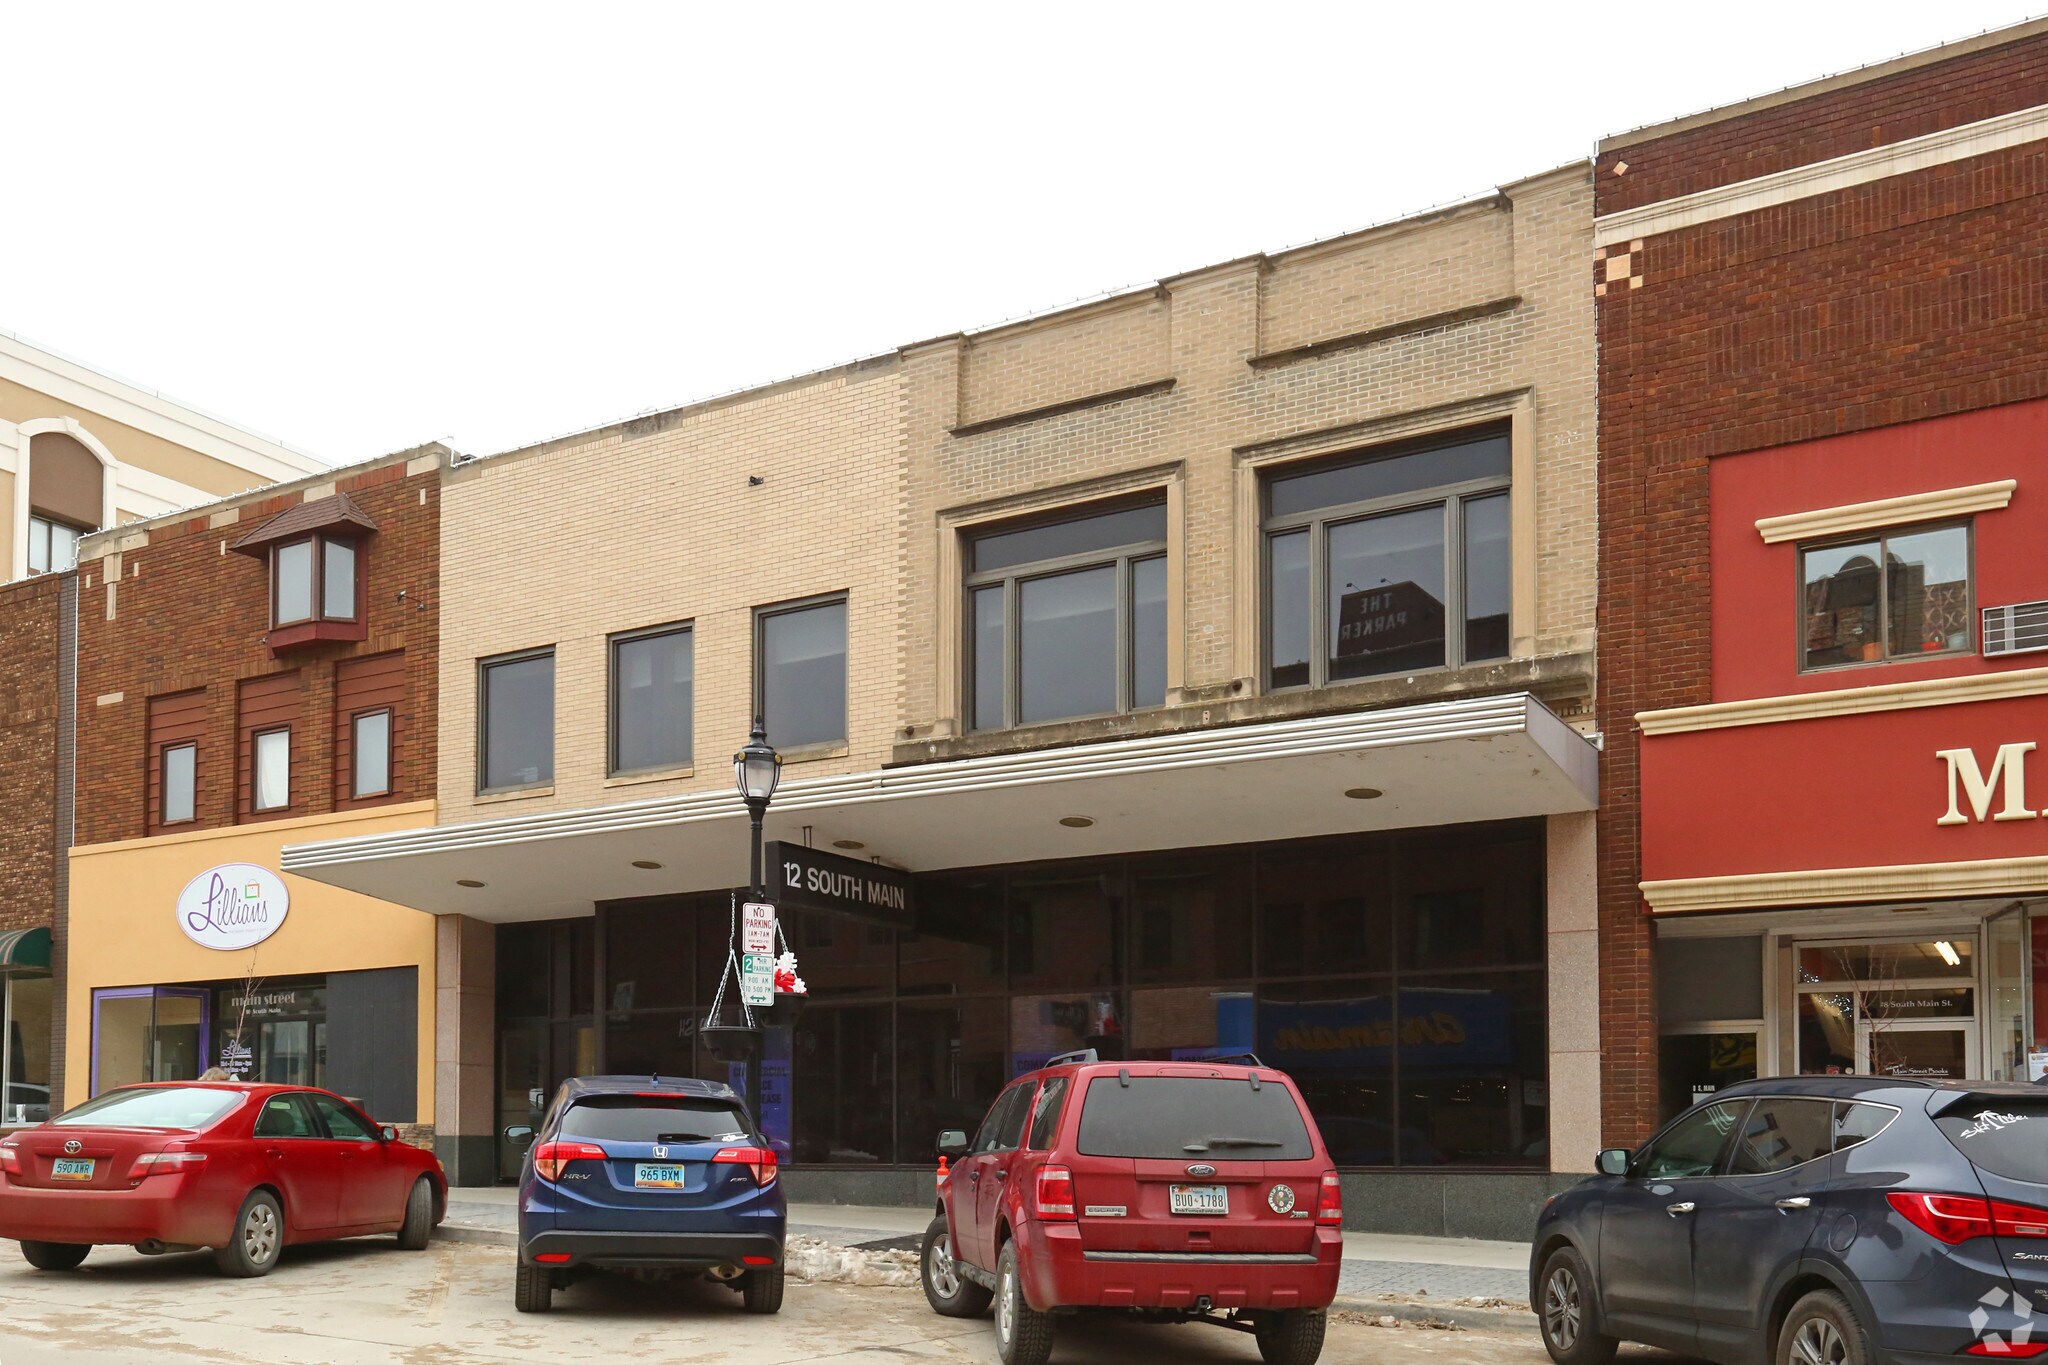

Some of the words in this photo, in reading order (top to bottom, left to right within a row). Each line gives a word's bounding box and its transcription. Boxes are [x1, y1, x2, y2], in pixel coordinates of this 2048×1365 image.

[1936, 742, 2048, 825] M
[784, 862, 801, 888] 12
[807, 867, 862, 901] SOUTH
[867, 881, 905, 910] MAIN
[753, 908, 764, 918] NO
[746, 919, 772, 930] PARKING
[745, 958, 752, 971] 2
[753, 965, 771, 973] PARKING
[264, 992, 295, 1005] street
[1890, 1000, 1915, 1008] South
[1941, 999, 1953, 1007] St.
[57, 1163, 72, 1173] 590
[640, 1169, 659, 1181] 965
[661, 1170, 680, 1181] BXM
[1200, 1194, 1224, 1208] 1788
